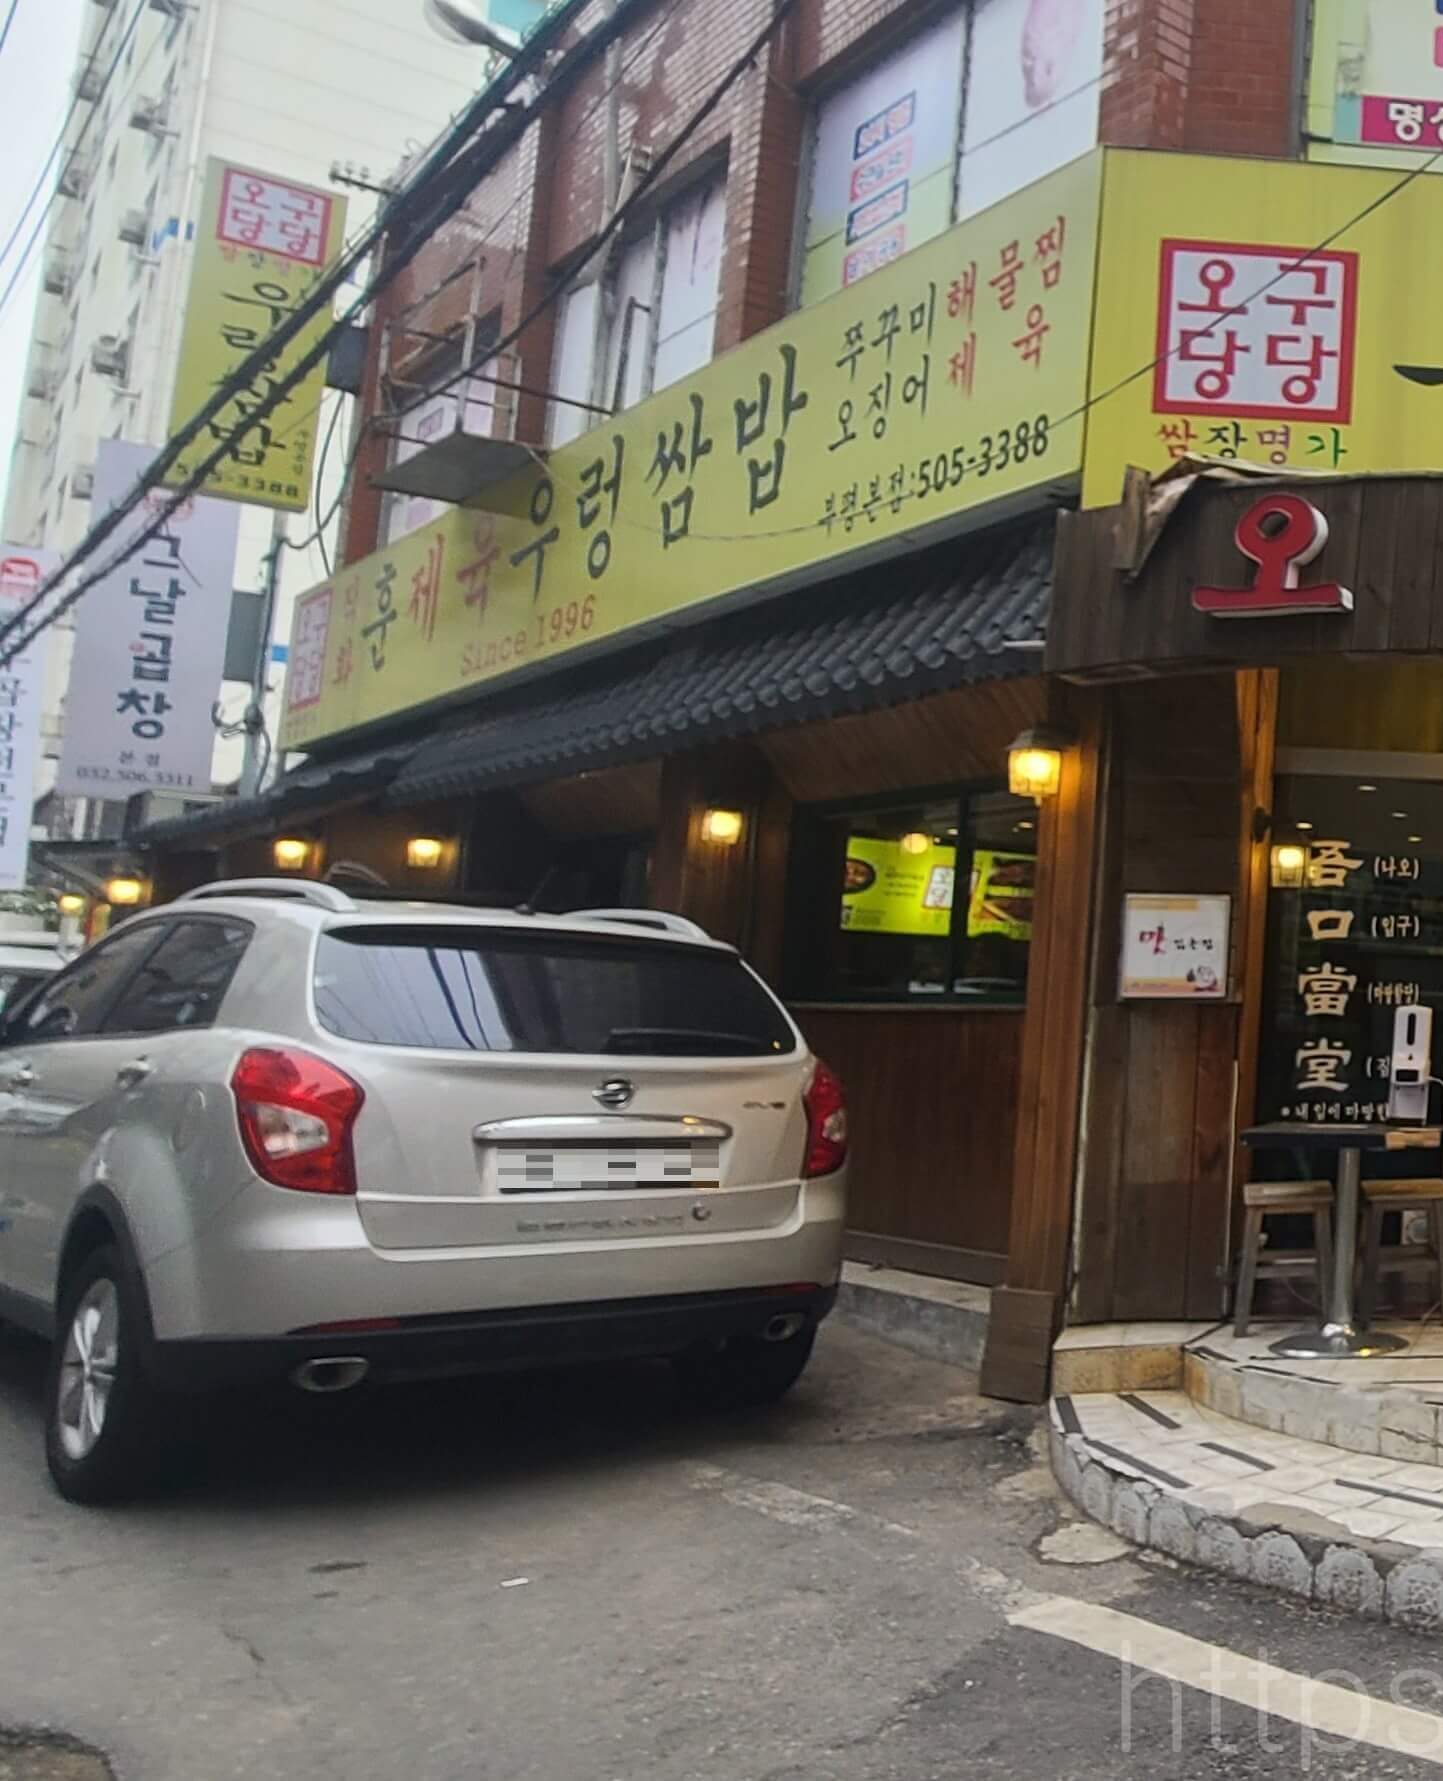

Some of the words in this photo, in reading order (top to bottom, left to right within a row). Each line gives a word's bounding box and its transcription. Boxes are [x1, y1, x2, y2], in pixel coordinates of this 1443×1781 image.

[828, 353, 931, 451] 오징어
[176, 463, 299, 498] 55-3388
[535, 594, 597, 650] 1996
